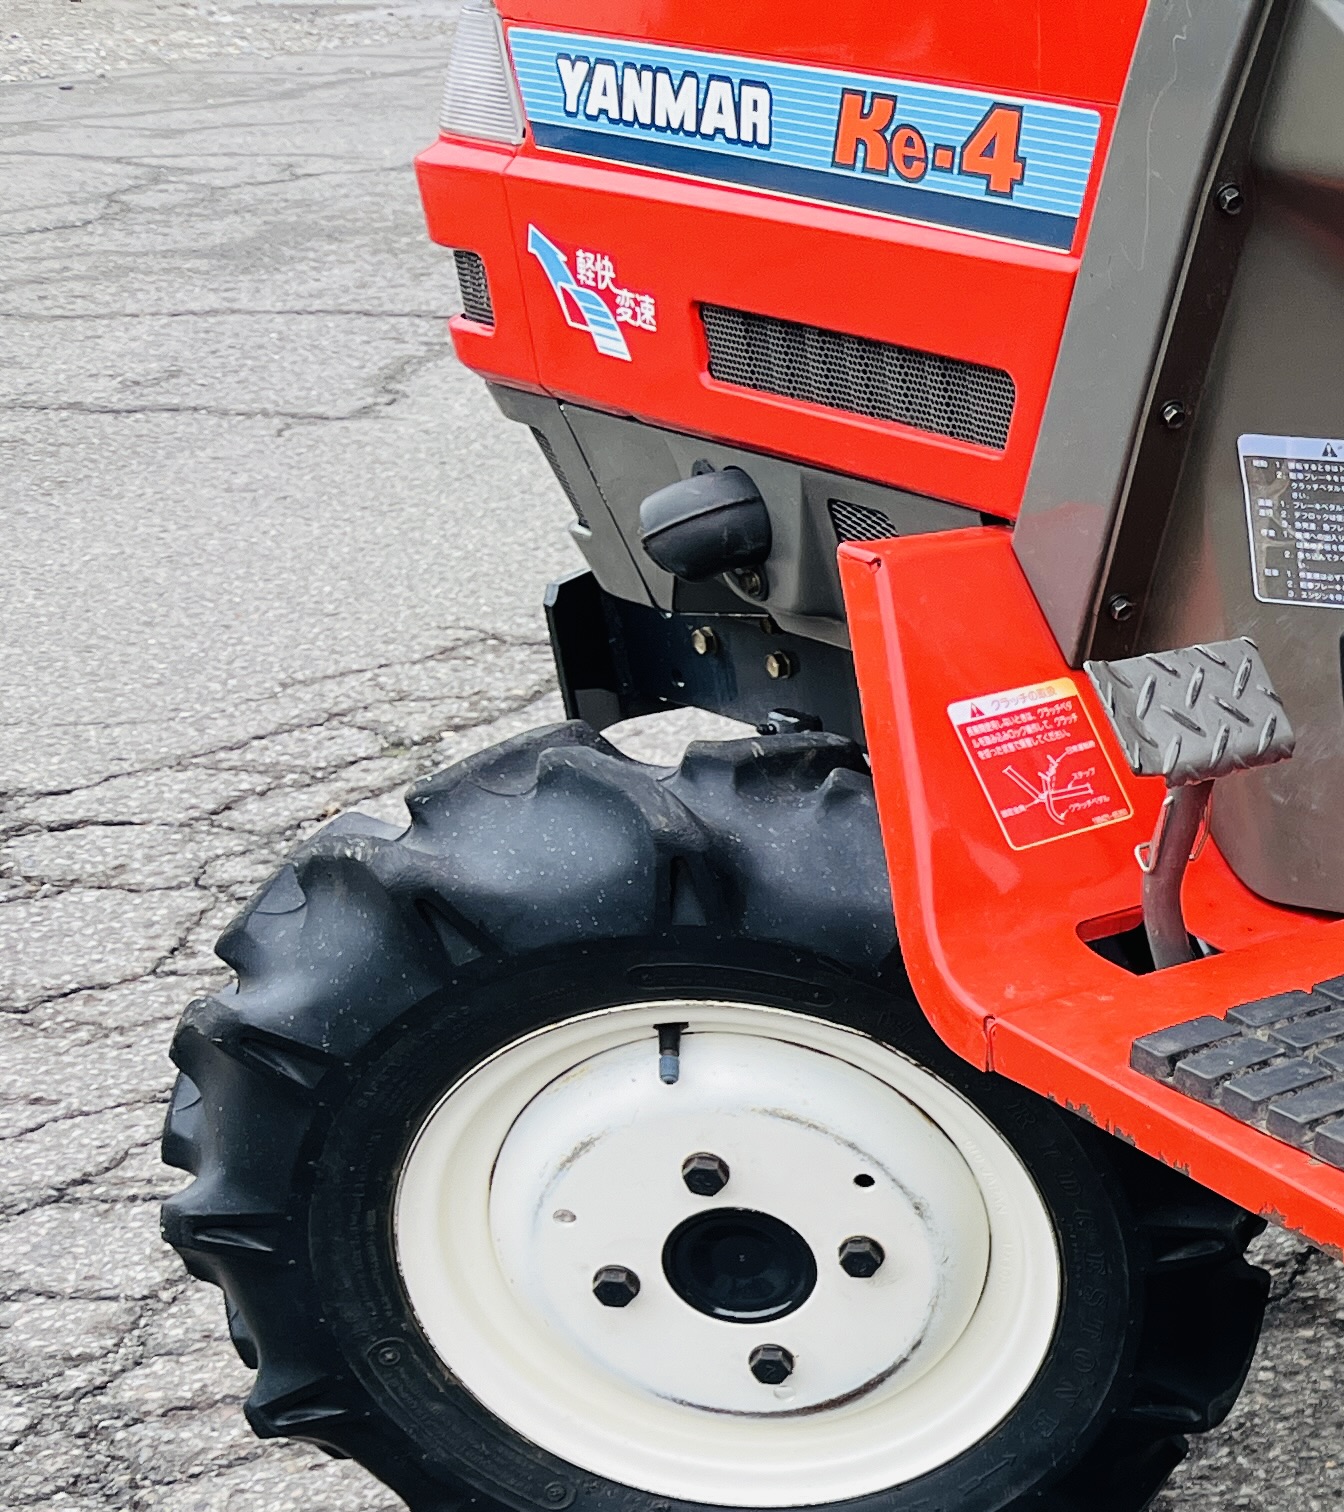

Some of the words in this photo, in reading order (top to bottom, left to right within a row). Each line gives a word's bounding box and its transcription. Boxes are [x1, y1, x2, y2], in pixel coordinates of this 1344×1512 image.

[556, 53, 773, 150] YANMAR
[832, 88, 1027, 199] Ke-4
[576, 249, 616, 291] 軽快
[615, 289, 657, 333] 変速
